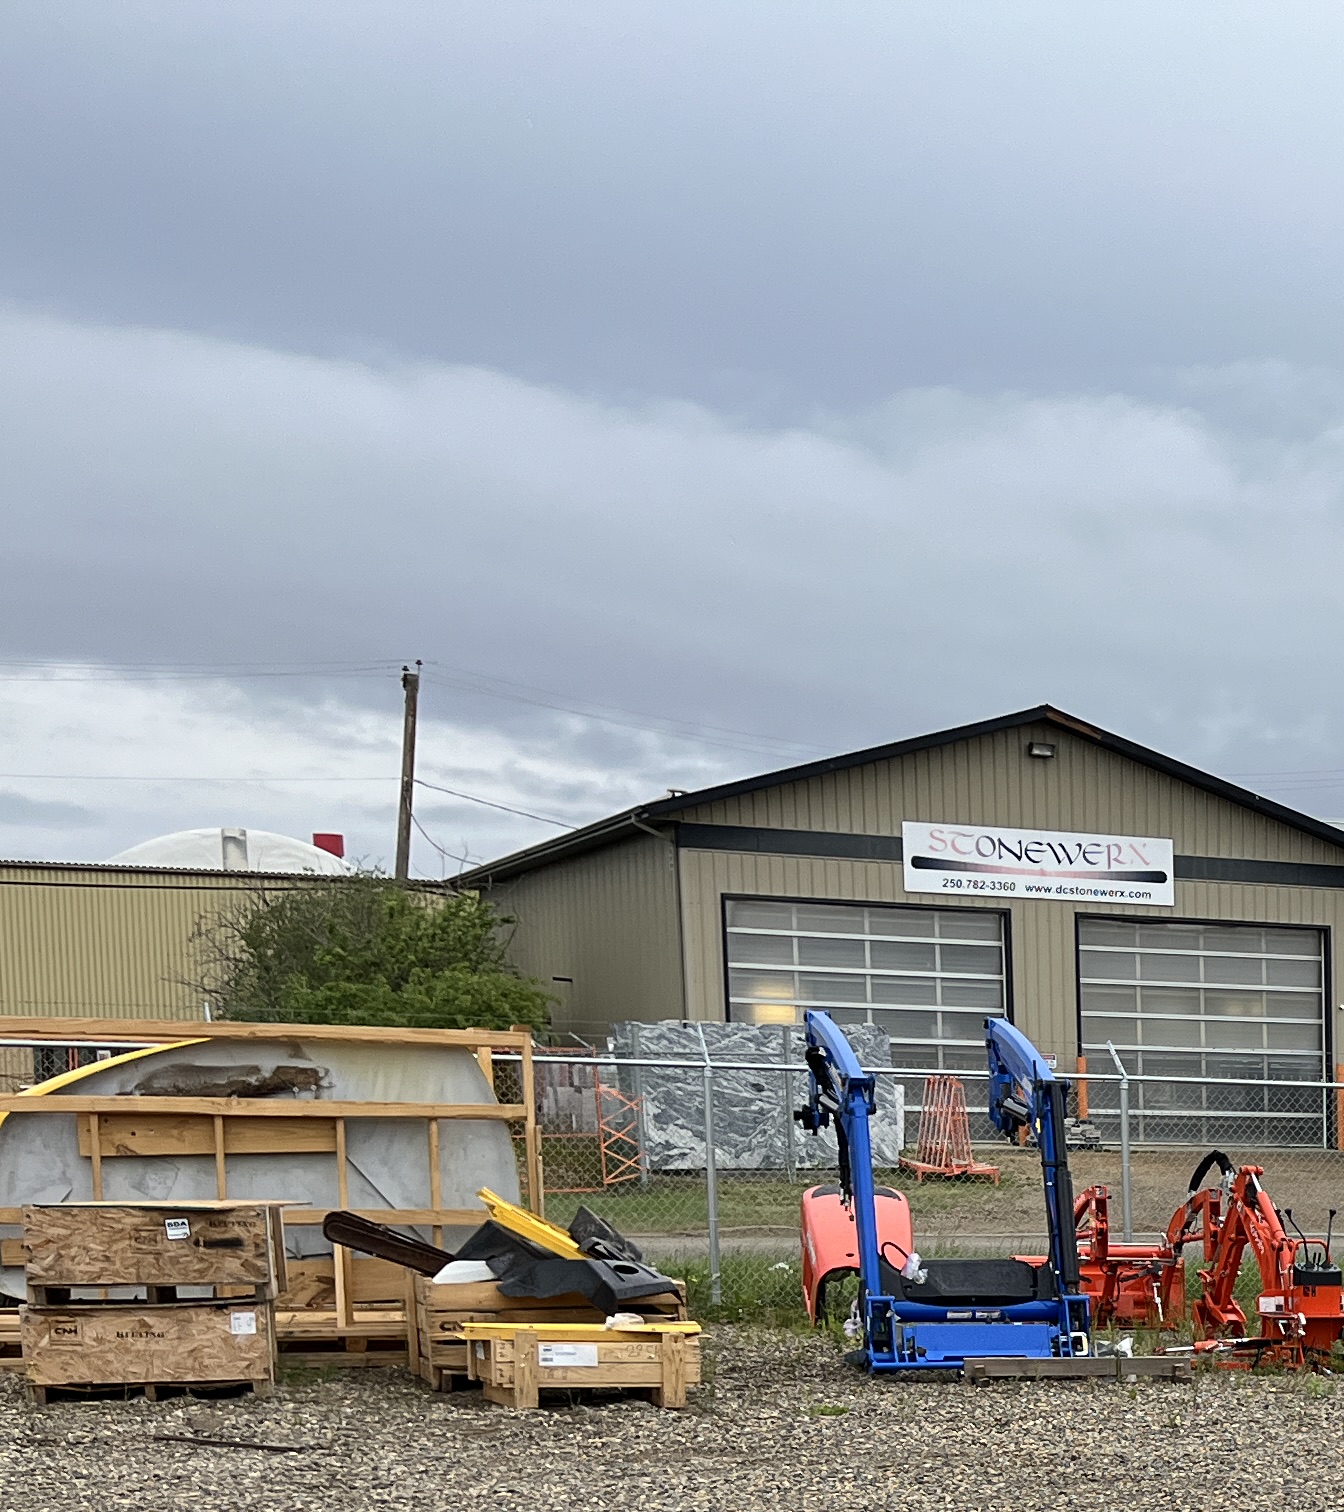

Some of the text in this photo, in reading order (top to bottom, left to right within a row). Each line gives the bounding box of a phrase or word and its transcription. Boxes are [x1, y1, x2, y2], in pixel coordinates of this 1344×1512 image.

[928, 828, 1151, 869] STONEWERX
[942, 878, 1152, 899] 250.782-3360 www.dcstonewerx.com
